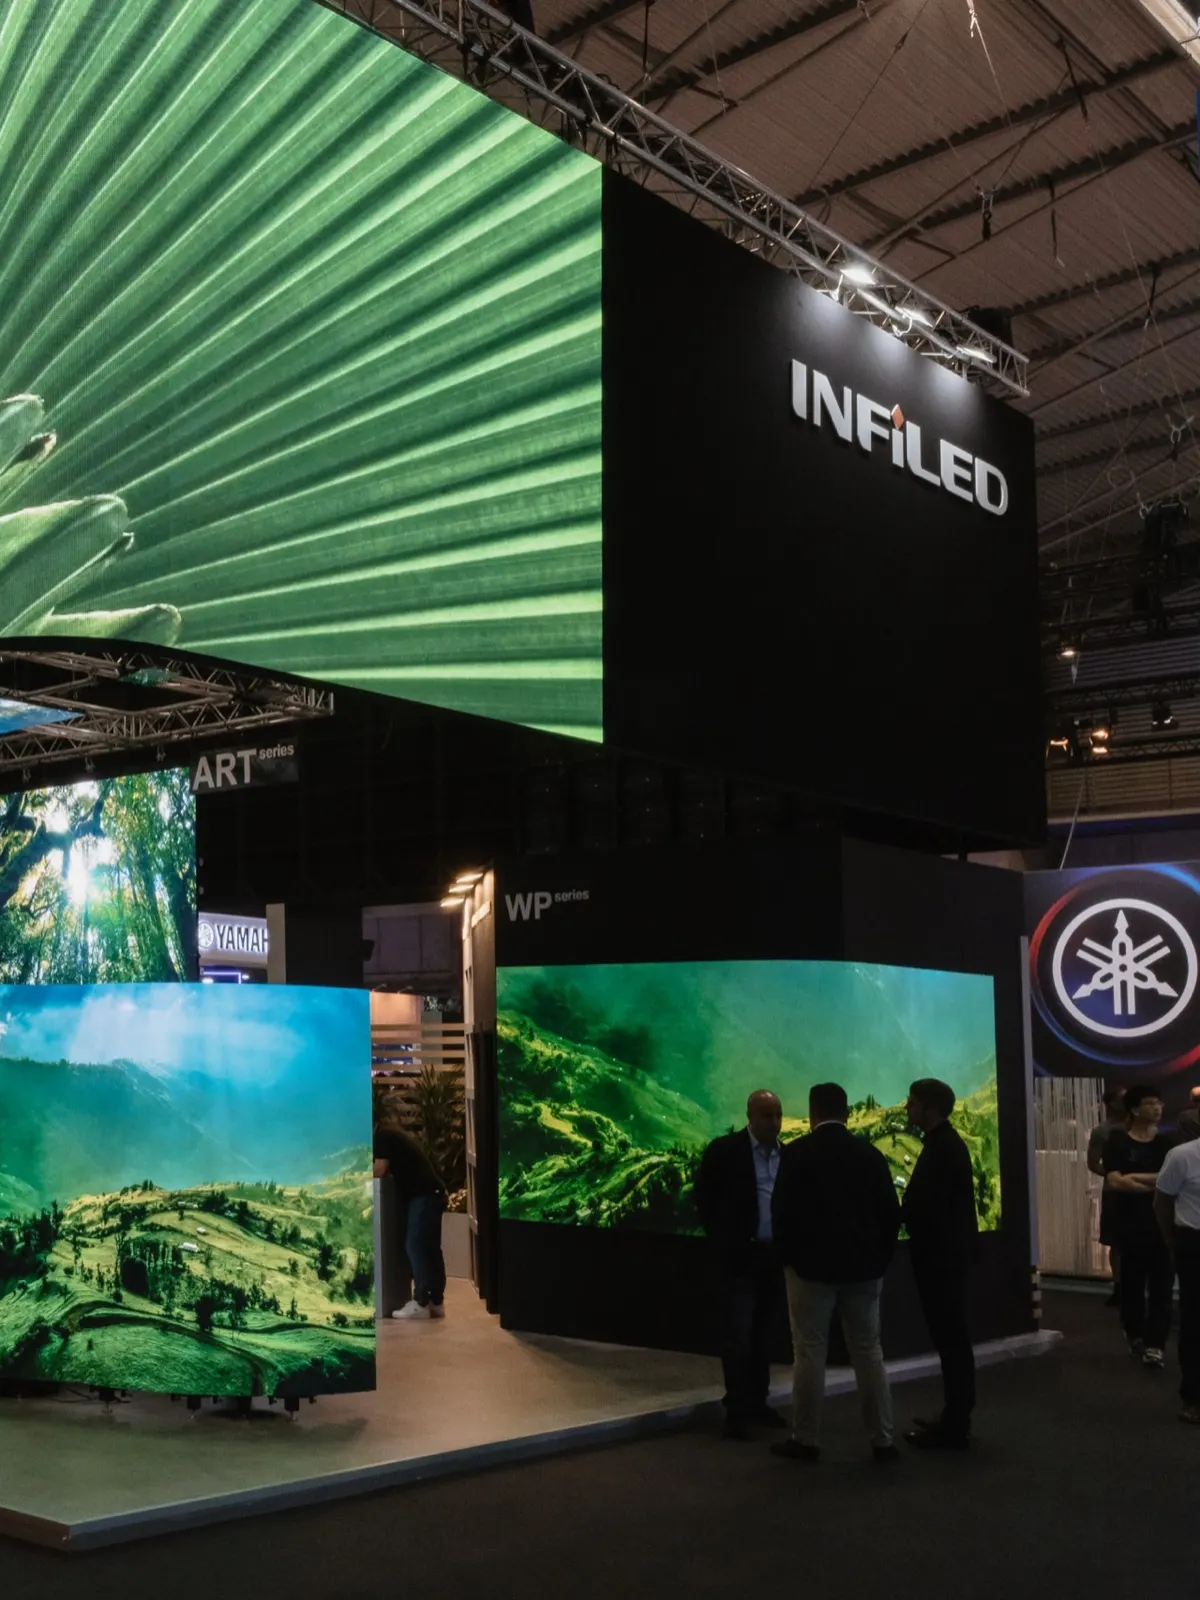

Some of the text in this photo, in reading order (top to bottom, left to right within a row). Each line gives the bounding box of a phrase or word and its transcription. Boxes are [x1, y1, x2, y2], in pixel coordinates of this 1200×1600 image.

[192, 744, 295, 791] ART series
[504, 889, 590, 921] WP series
